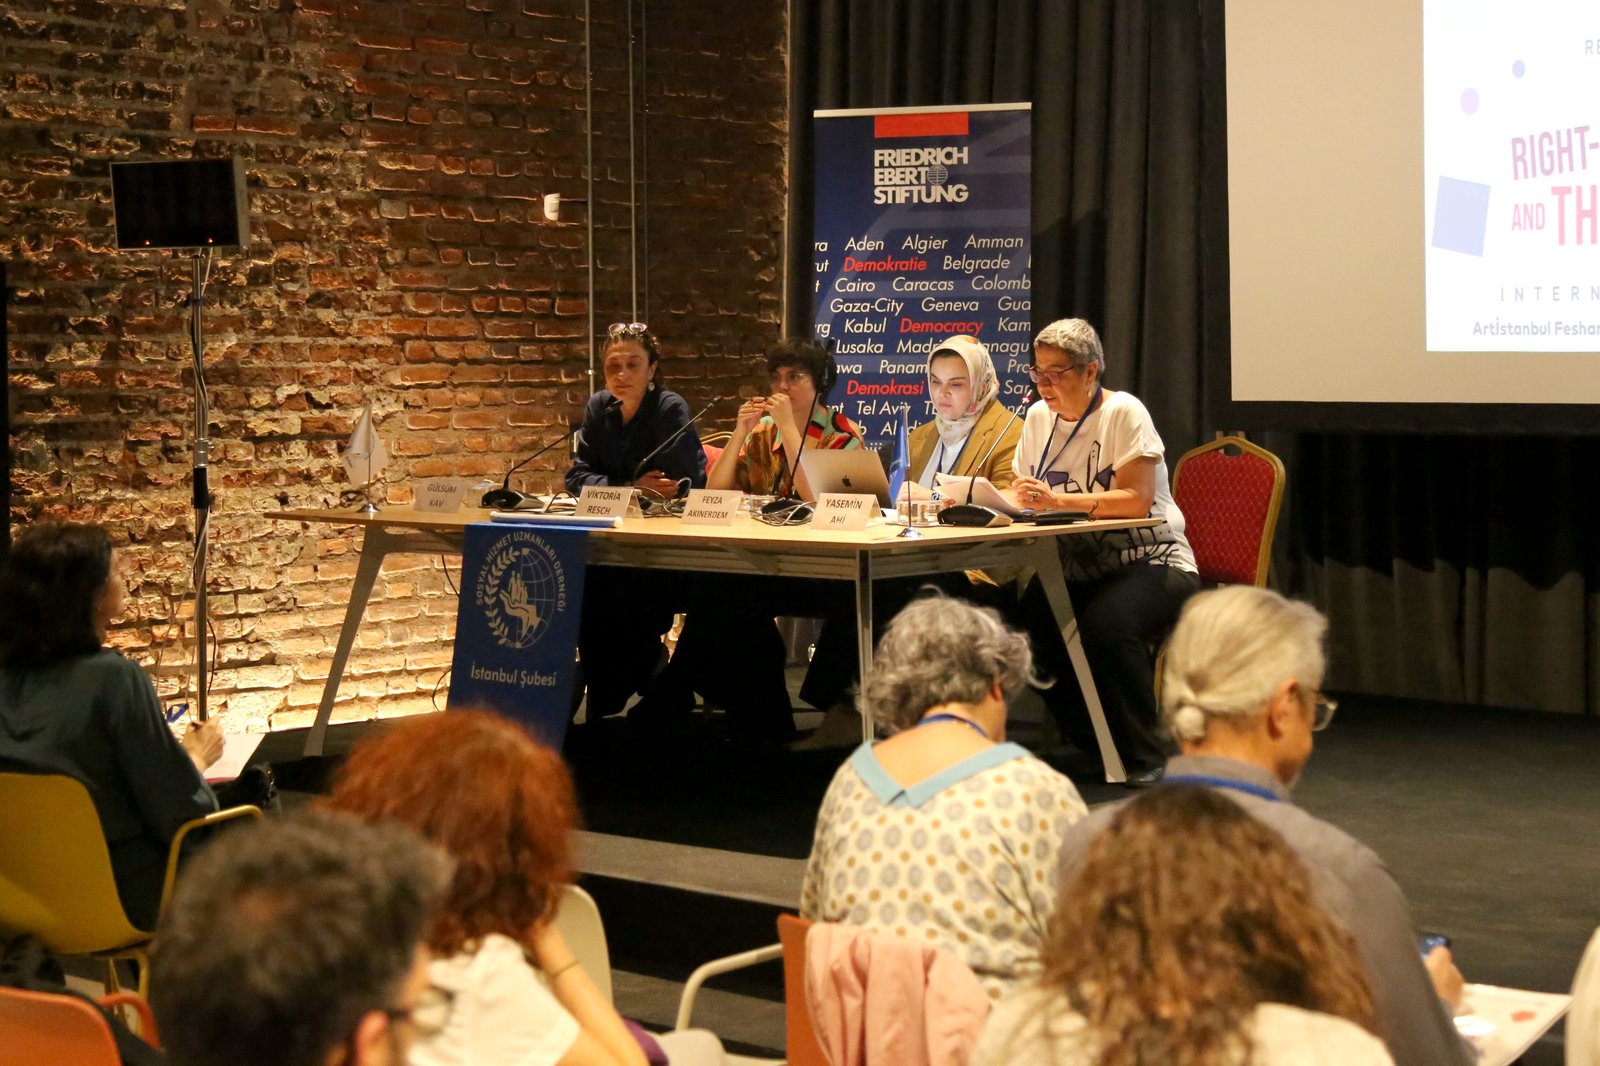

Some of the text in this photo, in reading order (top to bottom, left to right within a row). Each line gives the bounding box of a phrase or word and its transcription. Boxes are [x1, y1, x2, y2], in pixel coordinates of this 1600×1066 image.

[874, 146, 969, 167] FRIEDRICH
[874, 167, 928, 186] EBERT
[873, 184, 969, 205] STIFTUNG
[1511, 203, 1546, 231] AND
[844, 235, 885, 251] Aden
[901, 234, 948, 254] Algier
[964, 234, 1024, 249] Amman
[815, 259, 829, 273] ut
[843, 255, 928, 272] Demokratie
[943, 253, 1011, 274] Belgrade
[835, 277, 876, 293] Cairo
[892, 276, 955, 293] Caracas
[830, 297, 904, 316] Gaza-City
[921, 297, 980, 312] Geneva
[815, 323, 831, 338] rg
[844, 317, 887, 334] Kabul
[900, 318, 984, 336] Democracy
[836, 338, 884, 354] Lusaka
[879, 360, 928, 375] Panam
[847, 379, 925, 396] Demokrasi
[856, 399, 877, 416] Tel
[428, 499, 445, 508] KAV
[702, 495, 723, 505] FEYZA
[826, 498, 863, 509] YASEMİN
[587, 505, 611, 515] RESCH
[687, 510, 728, 520] AKINERDEM
[471, 661, 557, 688] İstanbul Şubesi
